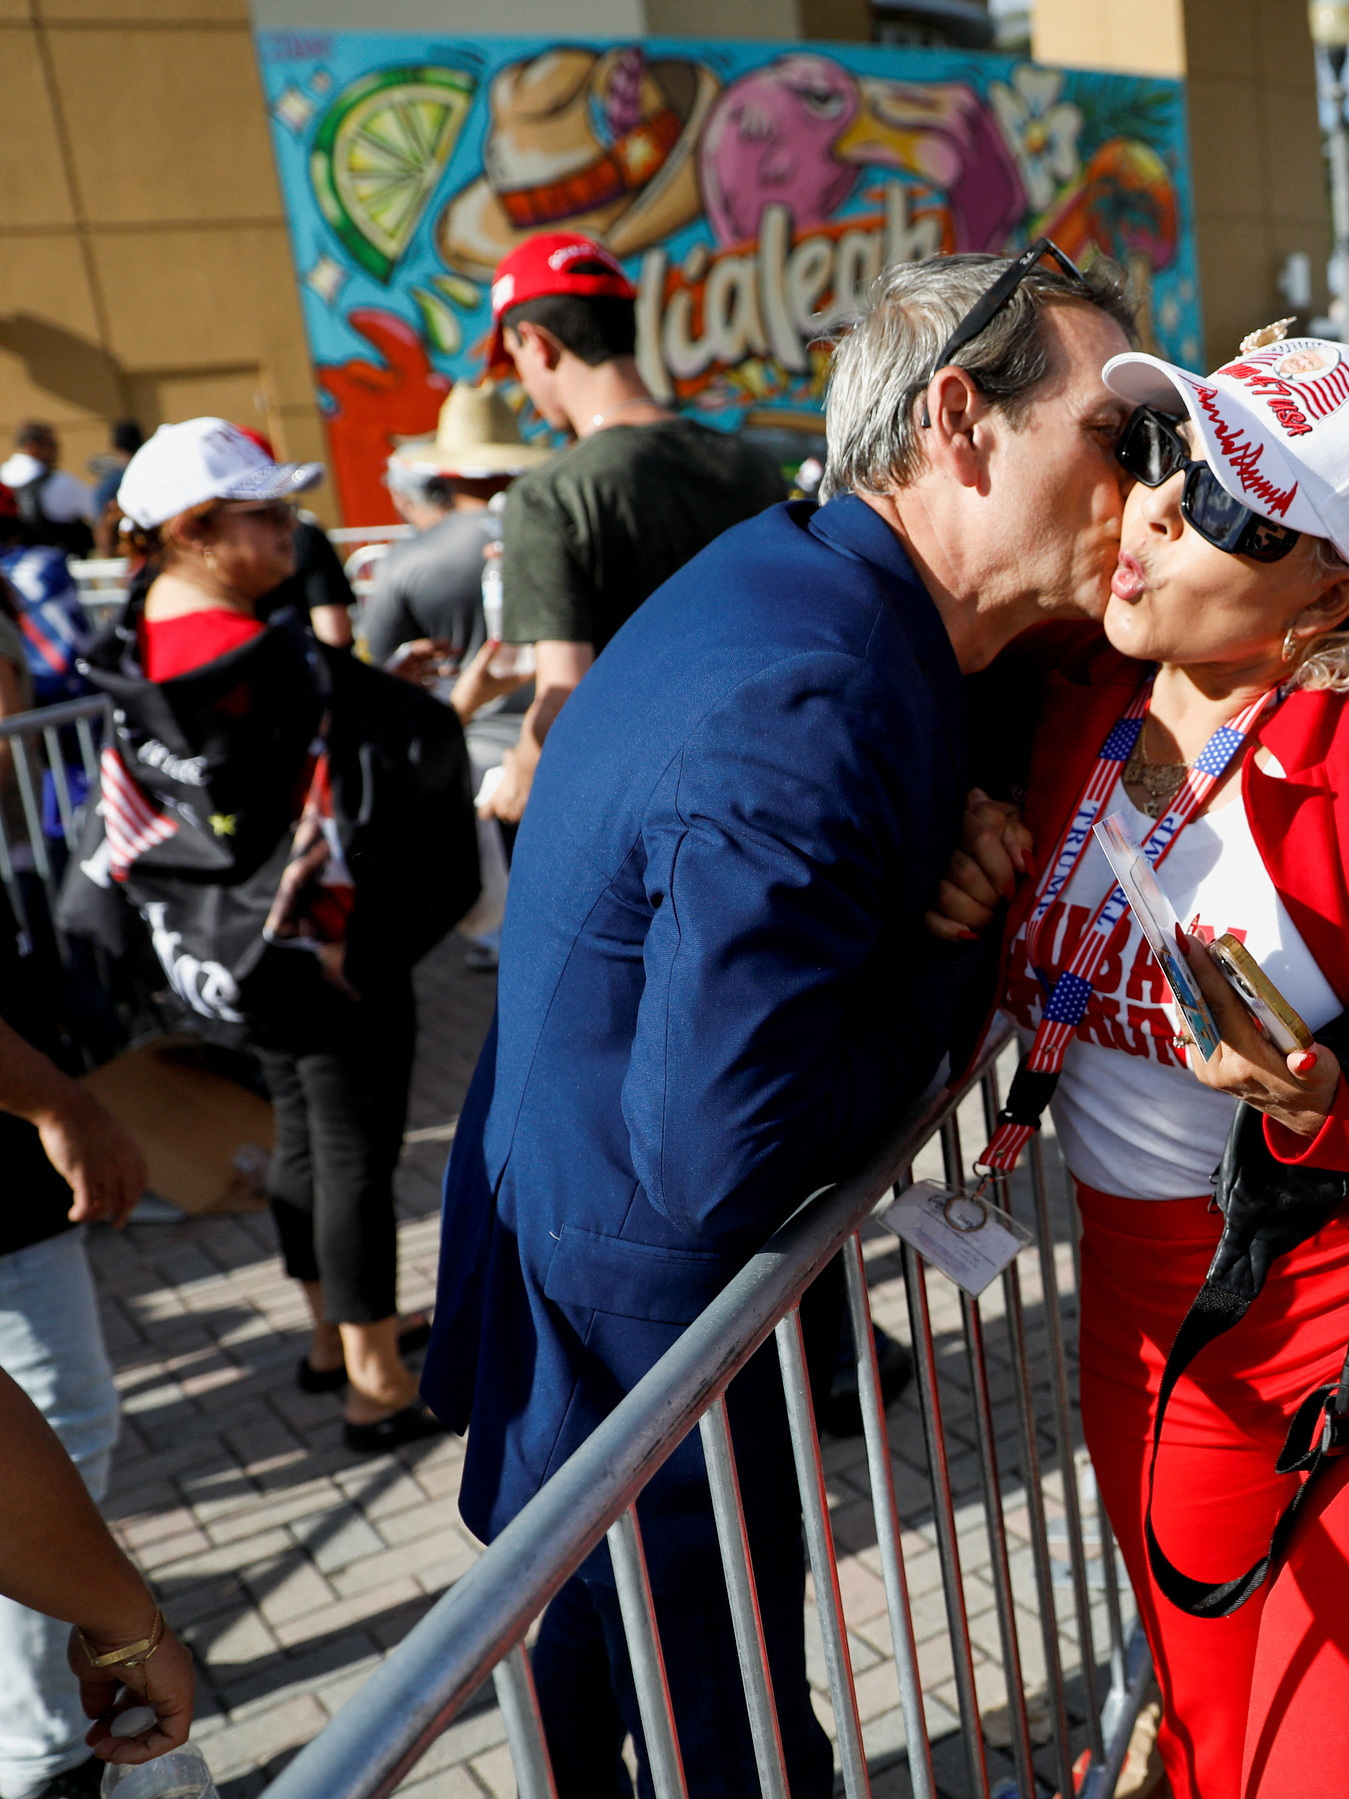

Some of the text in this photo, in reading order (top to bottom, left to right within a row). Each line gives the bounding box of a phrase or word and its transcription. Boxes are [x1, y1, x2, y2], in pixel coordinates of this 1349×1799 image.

[1267, 398, 1313, 437] USA
[1036, 804, 1099, 917] TRUMP
[1096, 814, 1179, 928] TRMP
